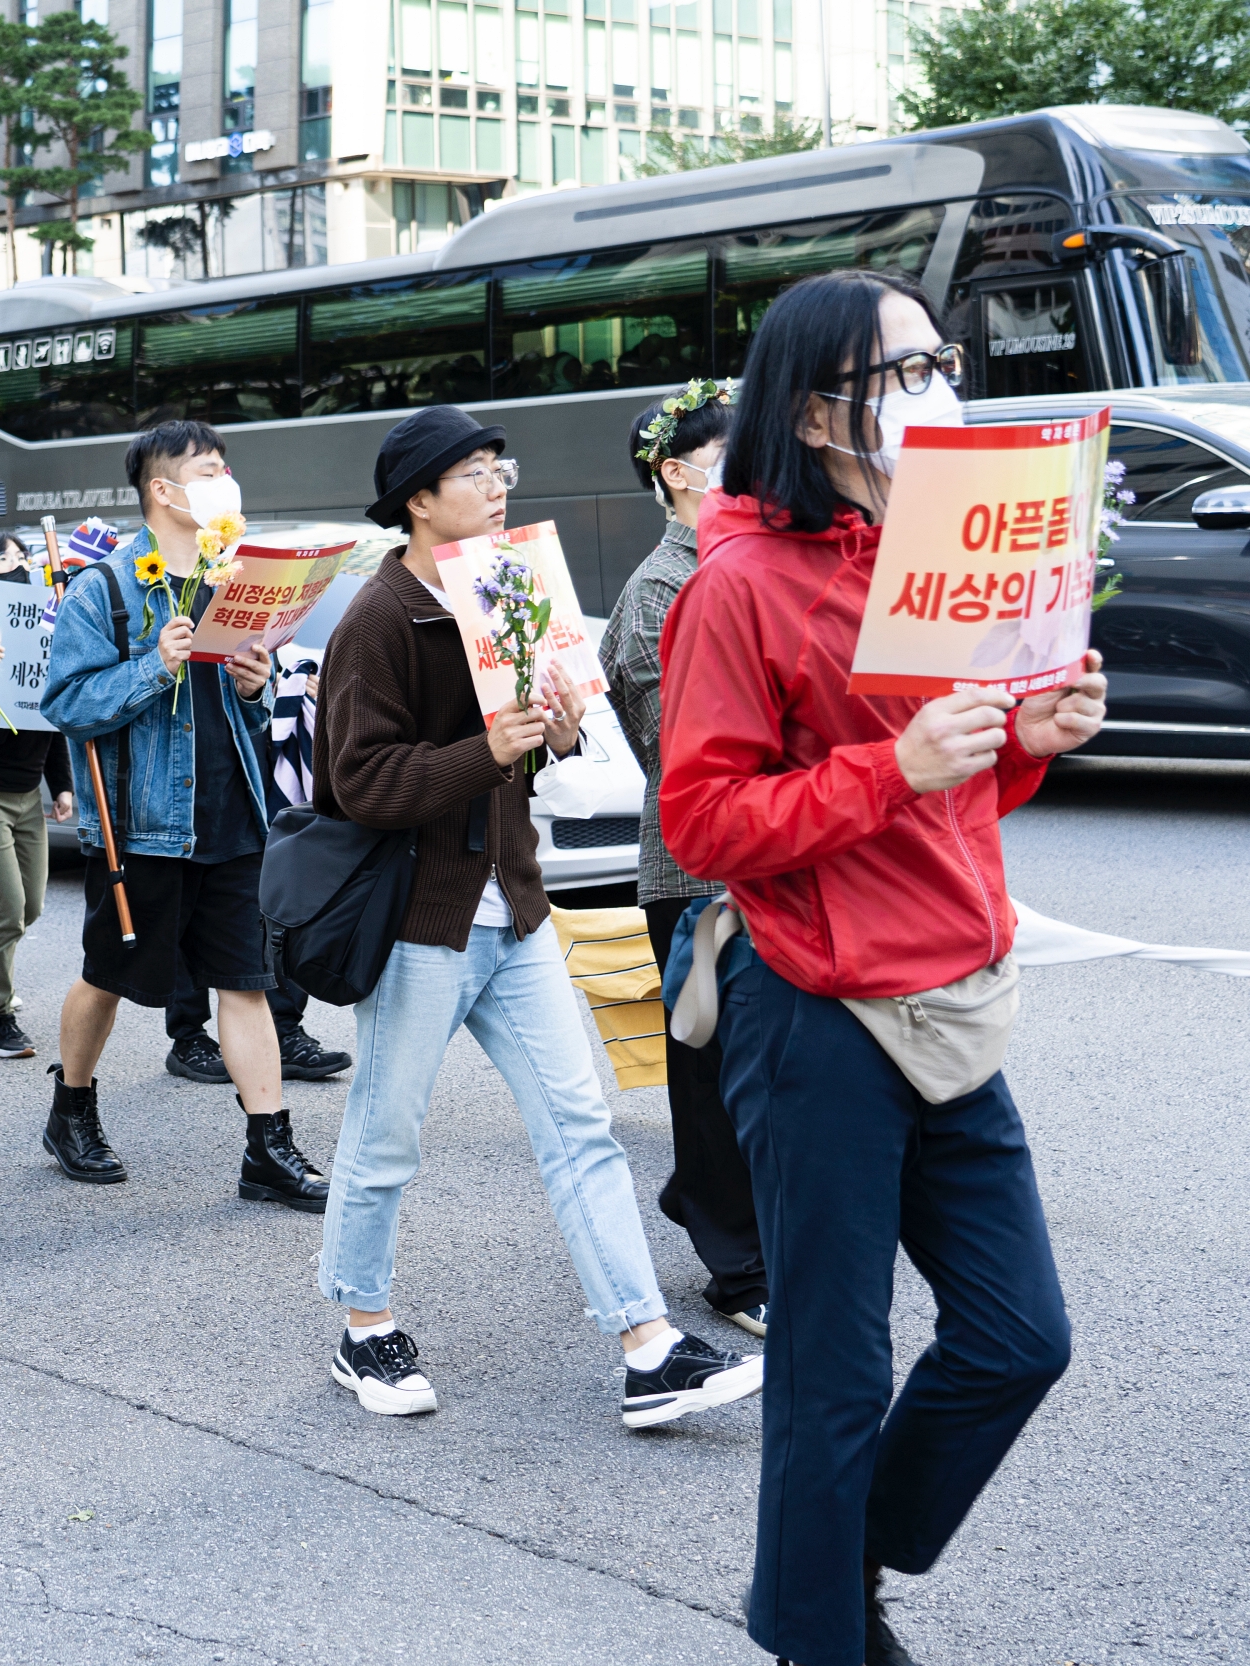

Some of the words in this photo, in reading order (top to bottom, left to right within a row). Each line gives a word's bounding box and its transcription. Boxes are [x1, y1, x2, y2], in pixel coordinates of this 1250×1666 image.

[989, 340, 1005, 357] VIP
[1005, 335, 1063, 355] LIMOUSINE
[16, 491, 62, 511] KOREA
[62, 488, 115, 509] TRAVEL
[961, 490, 1089, 553] 아픈몸이
[224, 583, 297, 606] 비정상의
[889, 570, 1036, 623] 세상의
[212, 607, 271, 631] 혁명을
